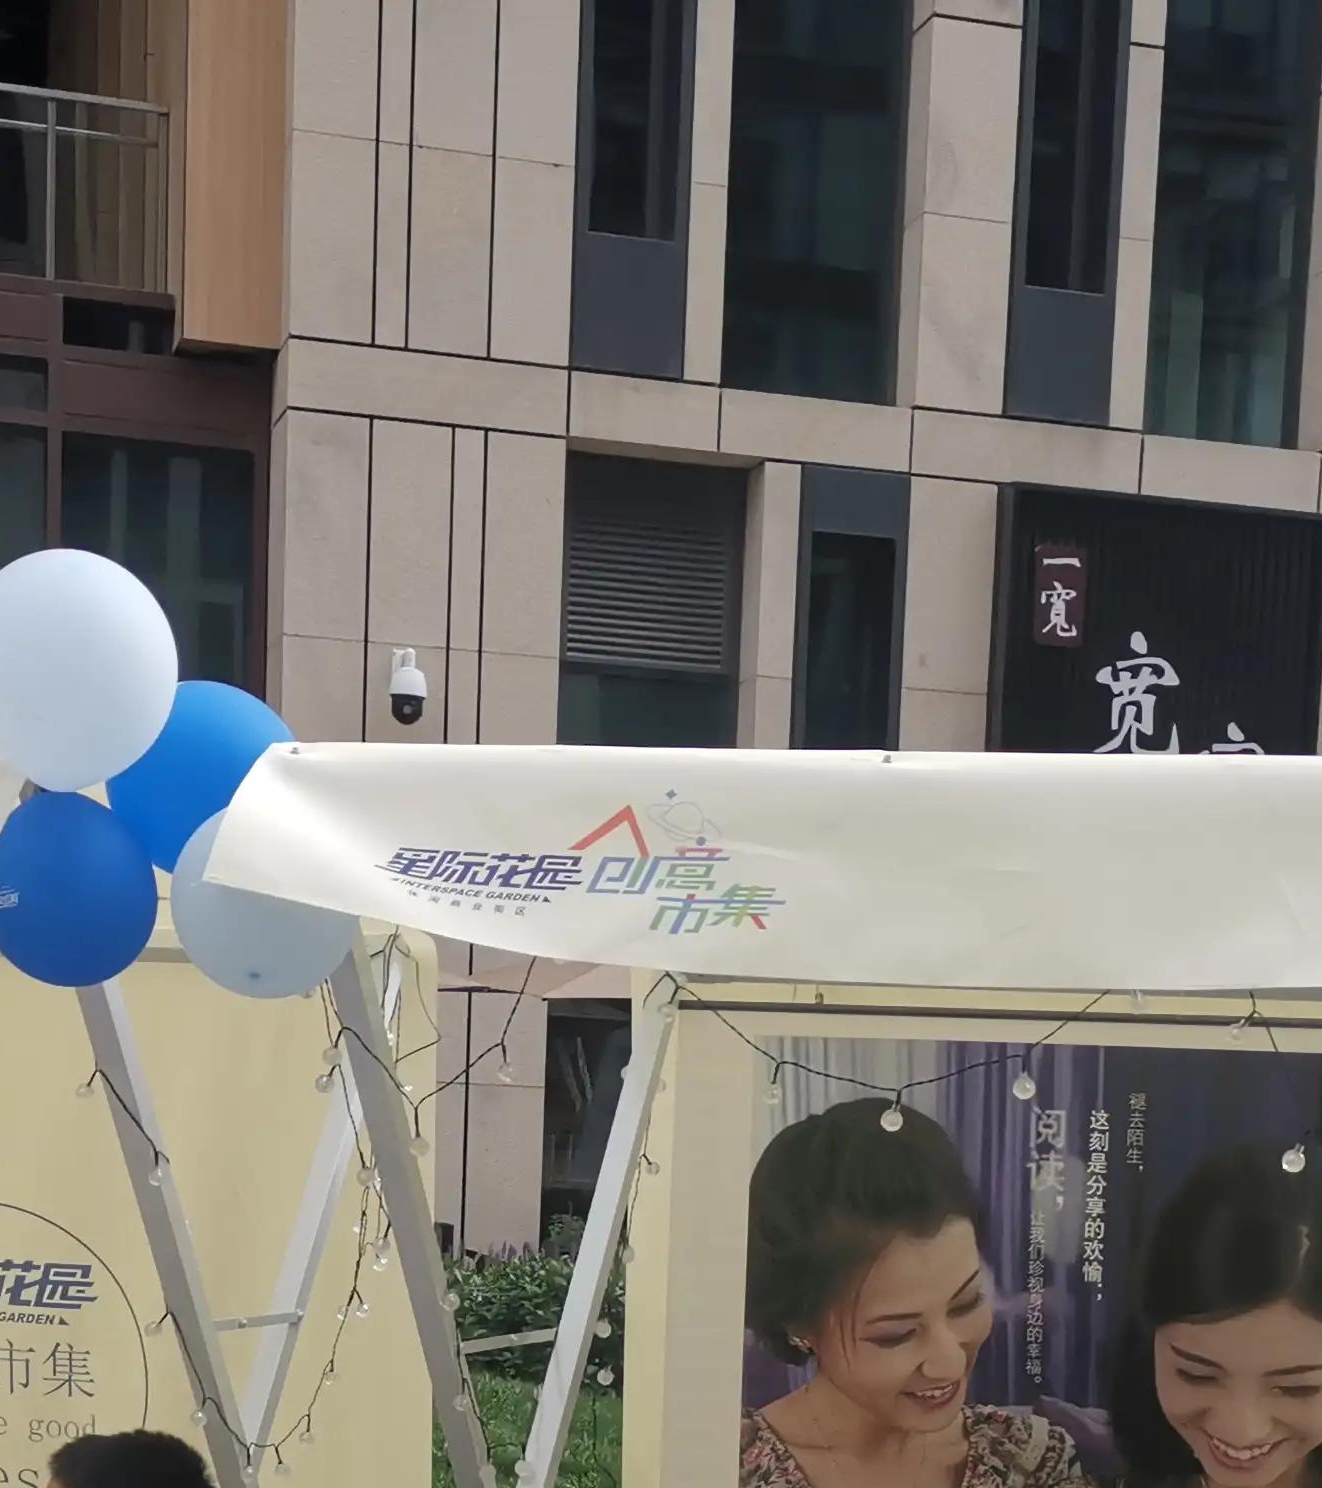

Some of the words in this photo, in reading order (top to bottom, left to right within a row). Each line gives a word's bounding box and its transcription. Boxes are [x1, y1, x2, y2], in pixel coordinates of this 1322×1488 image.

[374, 847, 587, 892] 星际花园
[398, 877, 483, 899] INTERSPACE
[485, 890, 541, 904] GARDEN
[649, 883, 786, 935] 市集
[28, 1414, 97, 1443] good
